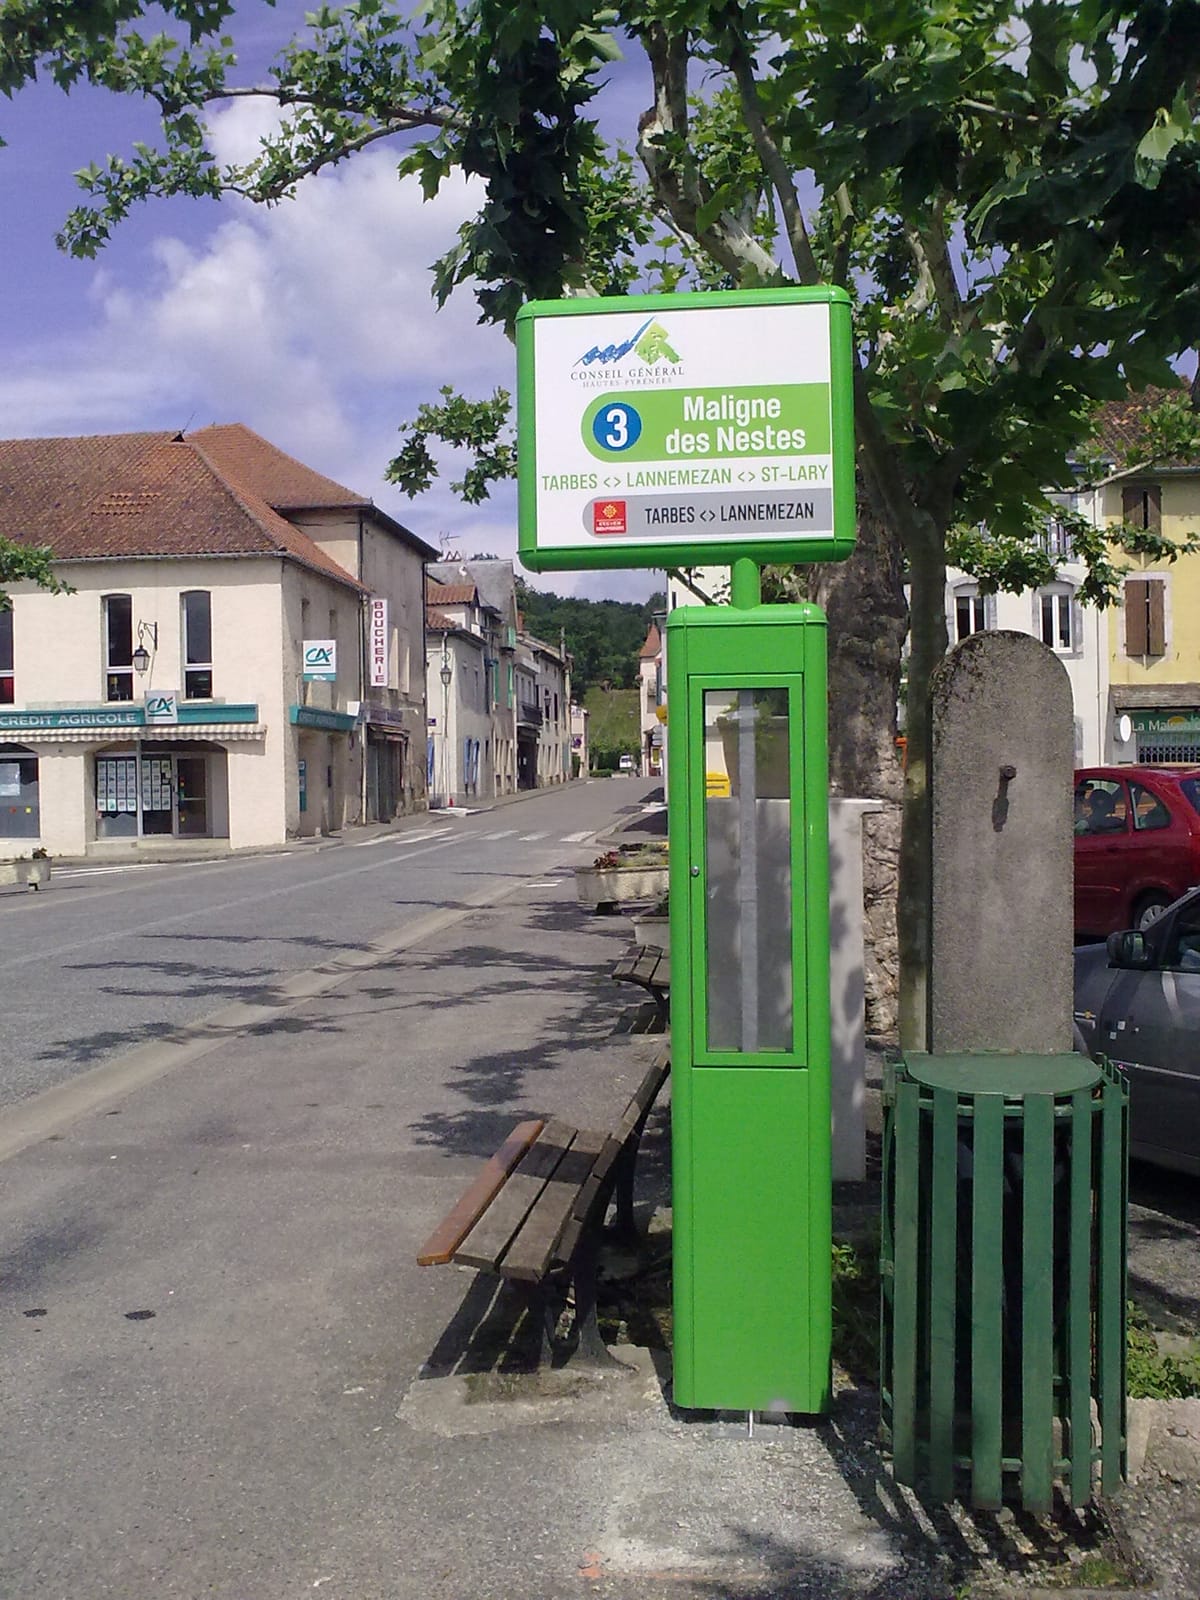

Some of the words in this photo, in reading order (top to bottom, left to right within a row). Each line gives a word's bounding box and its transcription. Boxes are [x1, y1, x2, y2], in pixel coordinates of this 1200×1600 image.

[570, 369, 623, 381] CONSEIL
[628, 366, 685, 378] GÉNÉRAL
[583, 380, 620, 388] HAUTES
[683, 395, 781, 427] Maligne
[606, 408, 628, 448] 3
[665, 429, 711, 454] des
[716, 424, 806, 452] Nestes
[542, 473, 598, 491] TARBES
[626, 468, 732, 487] LANNEMEZAN
[761, 464, 828, 482] ST-LARY
[644, 506, 695, 524] TARBES
[720, 502, 814, 522] LANNEMEZAN
[374, 601, 384, 683] BOUCHERIE
[58, 713, 136, 724] AGRICOLE
[1132, 720, 1145, 732] La
